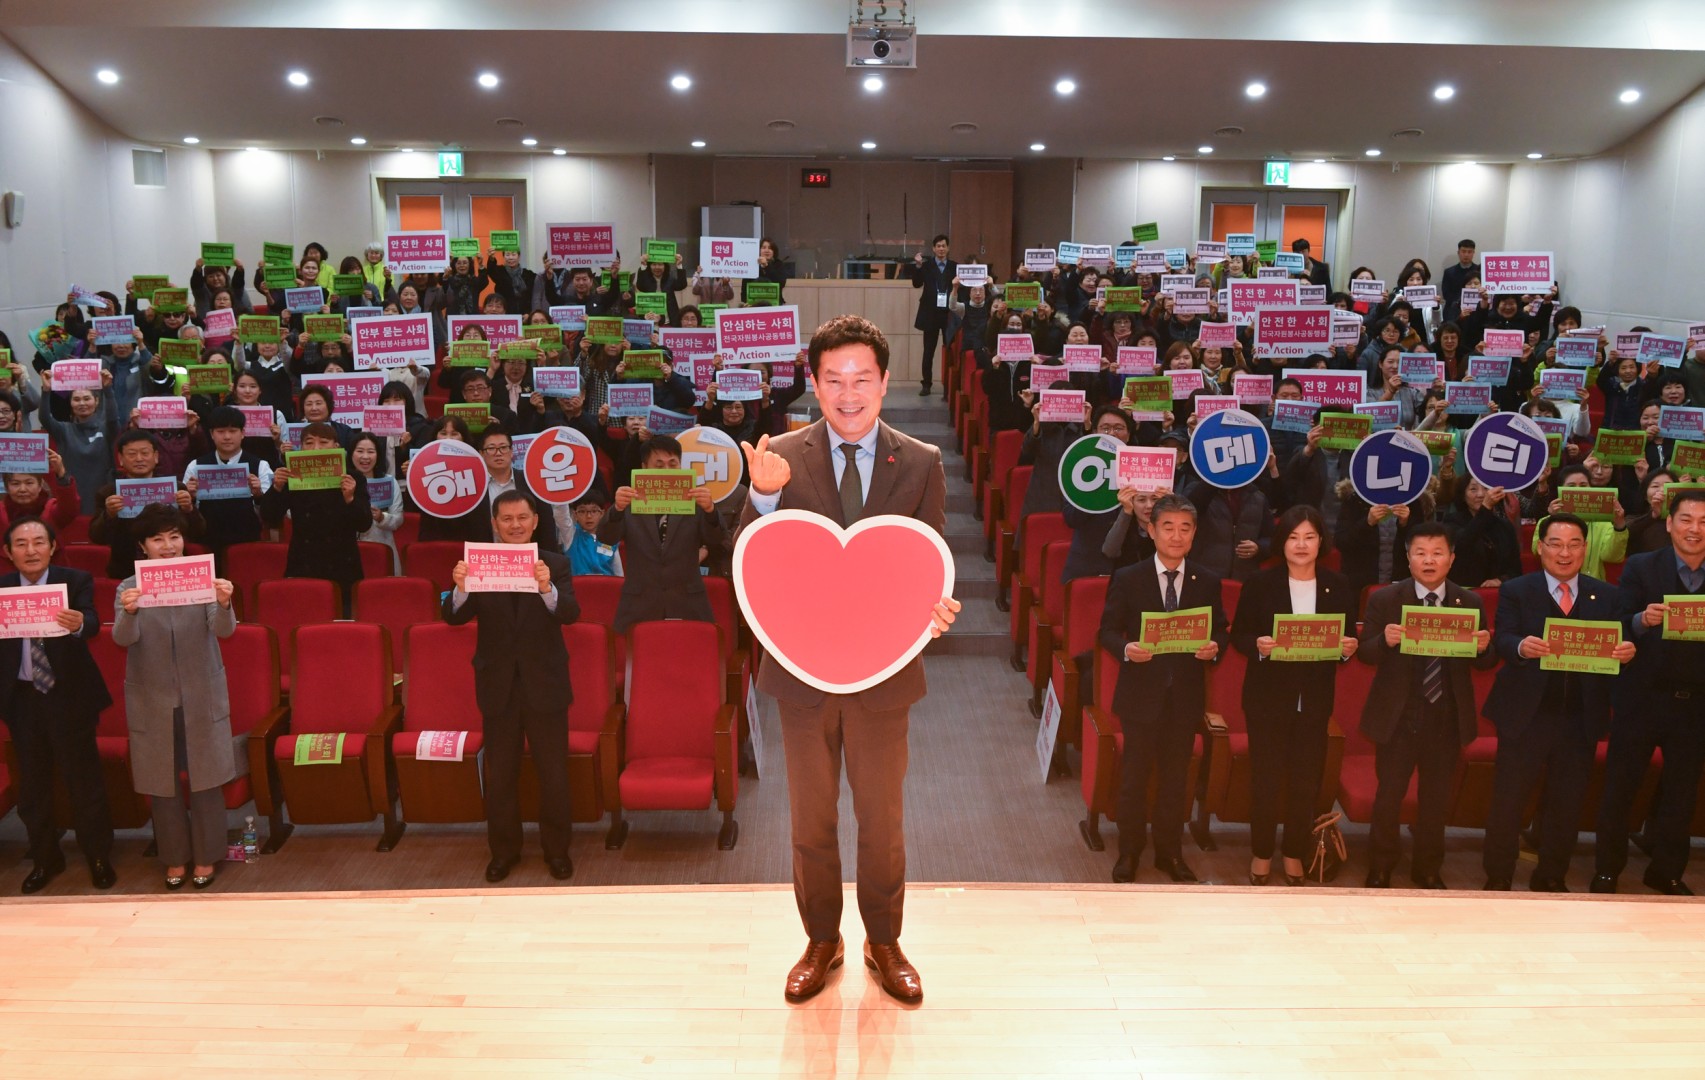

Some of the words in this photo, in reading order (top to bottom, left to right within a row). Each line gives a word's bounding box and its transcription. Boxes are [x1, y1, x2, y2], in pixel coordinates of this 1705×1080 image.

[553, 232, 569, 242] 안부
[573, 232, 590, 242] 묻는
[594, 232, 610, 241] 사회
[391, 239, 419, 249] 안전한
[424, 239, 442, 249] 사회
[715, 245, 730, 254] 안녕
[402, 263, 425, 271] Action
[724, 259, 748, 267] Action
[1487, 260, 1520, 270] 안전한
[1527, 260, 1548, 269] 사회
[1233, 288, 1266, 299] 안전한
[1274, 288, 1294, 298] 사회
[1485, 284, 1496, 292] Re
[723, 320, 766, 332] 안심하는
[771, 318, 792, 328] 사회
[1262, 316, 1296, 328] 안전한
[1305, 316, 1328, 327] 사회
[360, 327, 380, 339] 안부
[383, 326, 402, 338] 묻는
[406, 324, 426, 336] 사회
[498, 324, 516, 335] 사회
[1261, 330, 1326, 338] 전국자원봉사공동행동
[666, 338, 703, 348] 안심하는
[723, 332, 792, 343] 전국자원봉사공동행동
[360, 338, 427, 350] 전국자원봉사공동행동
[1643, 340, 1664, 348] 안전한
[722, 352, 734, 361] Re
[739, 350, 770, 360] Action
[1258, 346, 1268, 354] Re
[1274, 346, 1304, 354] Action
[358, 358, 370, 366] Re
[376, 356, 406, 365] Action
[336, 384, 357, 396] 묻는
[361, 383, 382, 394] 사회
[1304, 380, 1328, 393] 전한
[1335, 382, 1358, 394] 사회
[1323, 396, 1358, 406] NoNoNo
[1664, 413, 1686, 421] 안전한
[1690, 414, 1703, 422] 사회
[10, 442, 24, 451] 묻는
[28, 442, 43, 450] 사회
[1203, 433, 1257, 473] 메
[1481, 432, 1531, 475] 티
[291, 459, 322, 468] 안심하는
[325, 458, 340, 466] 사회
[1120, 456, 1149, 466] 안전한
[1156, 458, 1172, 467] 사회
[540, 444, 578, 492] 운
[1366, 455, 1413, 491] 니
[421, 461, 477, 504] 해
[636, 479, 672, 488] 안심하는
[674, 480, 691, 488] 사회
[122, 488, 137, 496] 안부
[157, 486, 172, 494] 사회
[1563, 494, 1590, 502] 안전한
[470, 554, 509, 564] 안심하는
[512, 554, 532, 564] 사회
[143, 570, 184, 582] 안심하는
[188, 566, 208, 576] 사회
[0, 599, 12, 610] 부
[16, 599, 36, 610] 묻는
[40, 597, 60, 608] 사회
[1147, 620, 1178, 632] 안전한
[1186, 618, 1206, 628] 사회
[1408, 617, 1442, 628] 안전한
[1450, 618, 1472, 630] 사회
[1279, 625, 1310, 636] 안전한
[1318, 626, 1338, 636] 사회
[1550, 630, 1585, 642] 안전한
[1594, 634, 1616, 644] 사회
